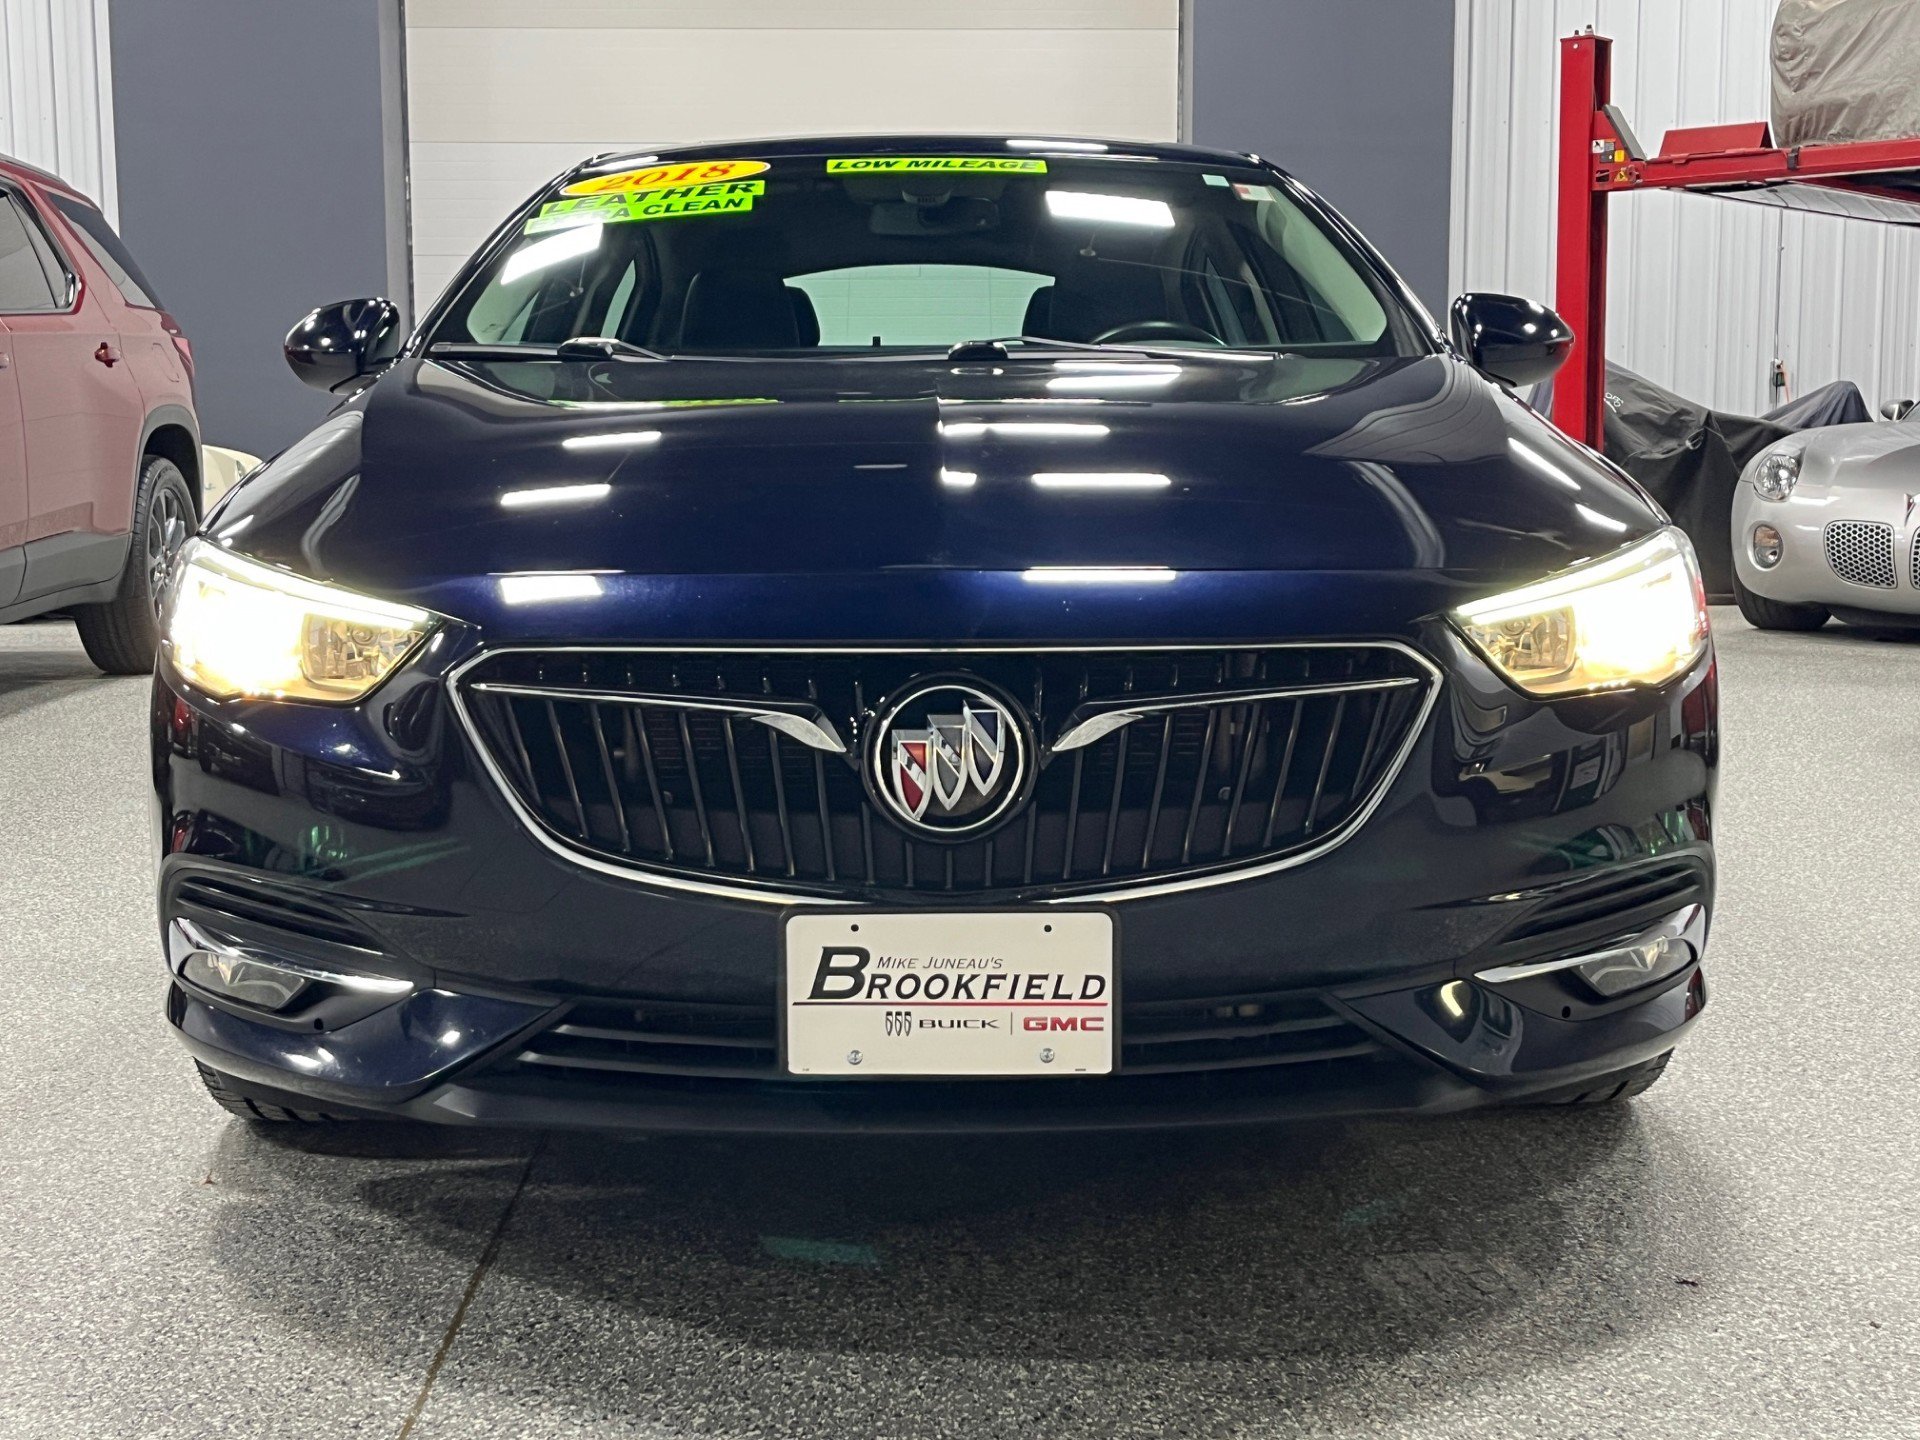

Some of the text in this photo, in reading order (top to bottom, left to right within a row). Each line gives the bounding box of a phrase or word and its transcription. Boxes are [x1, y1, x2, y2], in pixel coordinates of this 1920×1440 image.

[833, 160, 1039, 170] LOW MILEAGE
[595, 162, 736, 192] 2018
[545, 182, 756, 214] LEATHER
[643, 197, 744, 216] CLEAN
[876, 956, 1004, 969] MIKE JUNEAU'S
[807, 946, 1106, 1000] BROOKFIELD
[919, 1016, 1105, 1032] BUICK GMC
